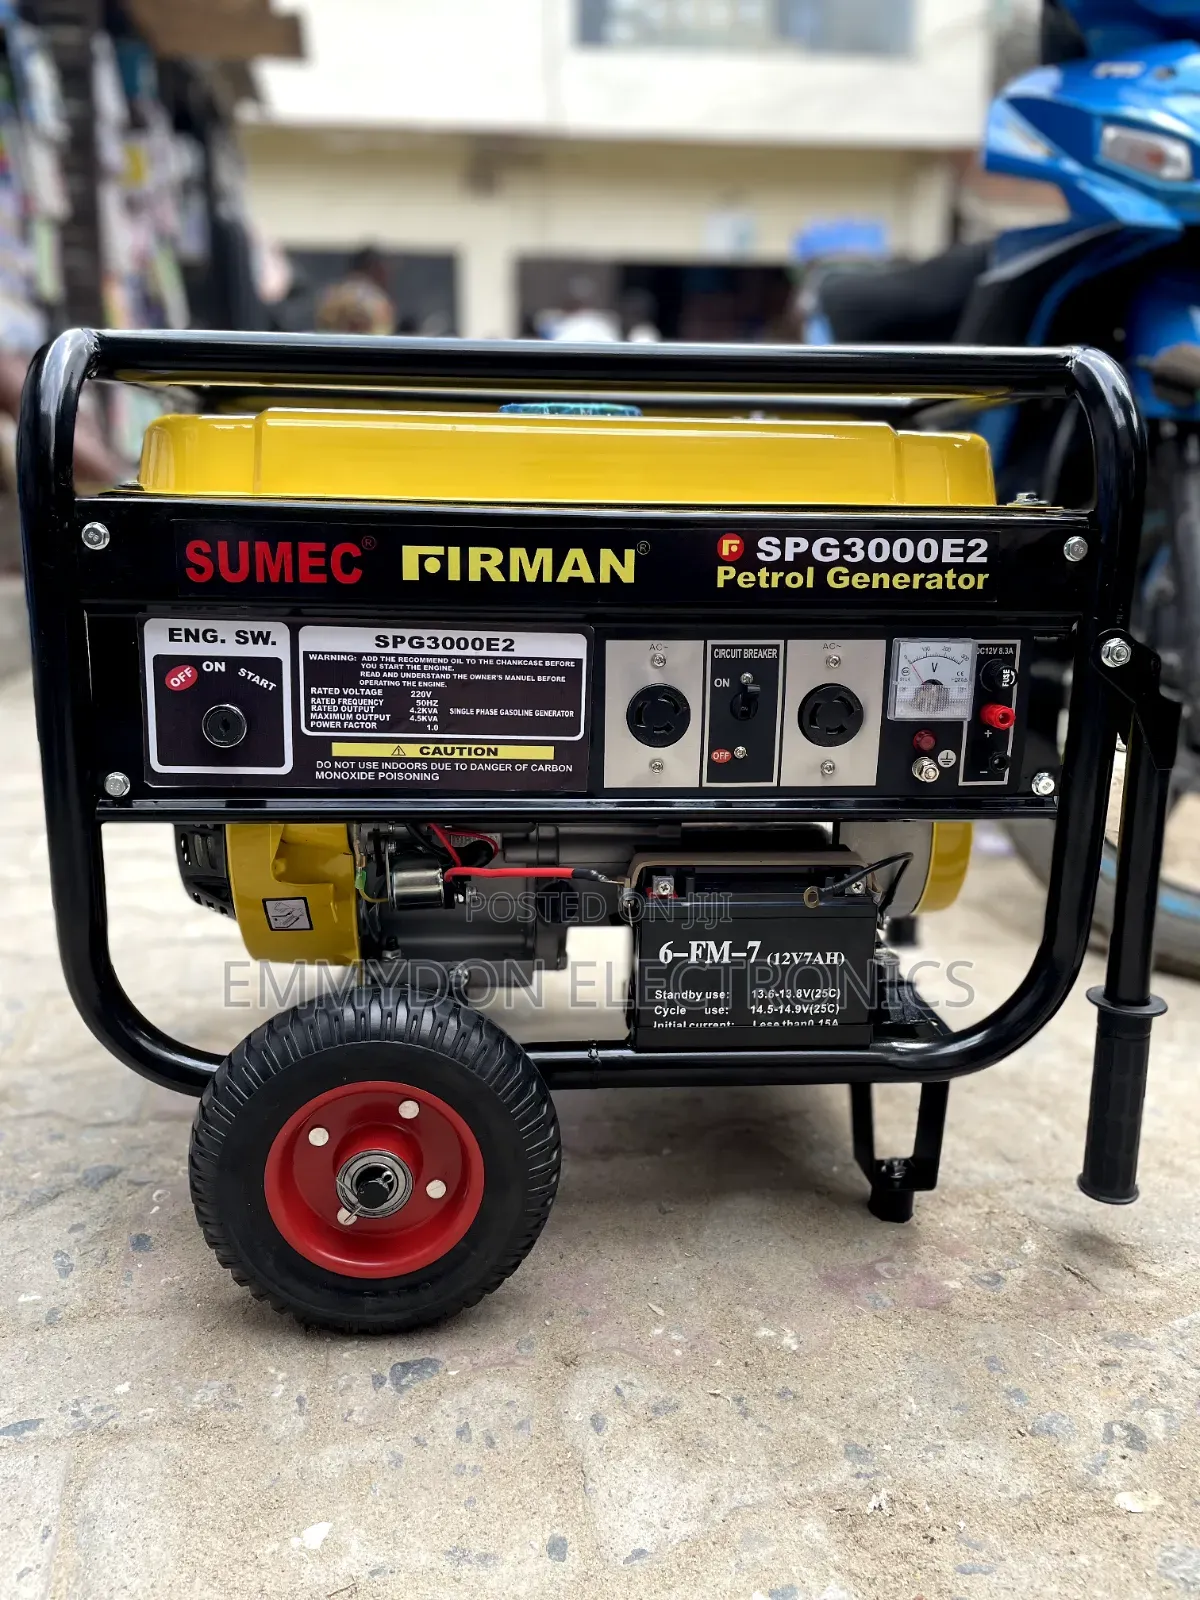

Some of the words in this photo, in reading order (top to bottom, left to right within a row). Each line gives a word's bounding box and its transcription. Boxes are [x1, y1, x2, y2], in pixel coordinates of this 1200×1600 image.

[756, 536, 989, 563] SPG3000E2
[717, 565, 815, 589] Petrol
[826, 566, 989, 590] Generator
[168, 627, 226, 644] ENG.
[235, 629, 277, 646] SW.
[374, 634, 515, 652] SPG3000E2
[713, 648, 742, 659] CIRCUIT
[743, 648, 778, 659] BREAKER
[309, 653, 357, 662] WARNING:
[380, 655, 396, 663] THE
[398, 656, 449, 664] RECOMMEND
[545, 660, 576, 668] BEFORE
[202, 661, 226, 672] ON
[423, 664, 455, 672] ENGINE.
[931, 662, 938, 673] V
[170, 666, 193, 687] OFF
[238, 667, 277, 692] START
[400, 672, 451, 680] UNDERSTAND
[1002, 669, 1011, 687] FUSE
[713, 678, 730, 688] ON
[310, 687, 340, 696] RATED
[342, 687, 384, 696] VOLTAGE
[410, 690, 432, 698] 220V
[310, 697, 336, 705] RATED
[338, 698, 384, 706] FREQUENCY
[415, 699, 439, 707] 50HZ
[340, 705, 375, 713] OUTPUT
[409, 707, 439, 715] 4.2KVA
[449, 707, 475, 715] SINGLE
[475, 708, 499, 716] PHASE
[500, 708, 533, 717] GASOLINE
[534, 709, 575, 718] GENERATOR
[310, 713, 354, 721] MAXIMUM
[355, 713, 391, 722] OUTPUT
[409, 714, 439, 723] 4.5KVA
[310, 721, 342, 729] POWER
[343, 721, 378, 730] FACTOR
[426, 724, 439, 732] 1.0
[419, 746, 499, 757] CAUTION
[713, 751, 730, 760] OFF
[316, 760, 332, 769] DO
[334, 761, 356, 770] NOT
[358, 761, 380, 770] USE
[381, 762, 428, 771] INDOORS
[430, 762, 452, 771] DUE
[454, 762, 468, 771] TO
[470, 763, 513, 772] DANGER
[514, 763, 529, 772] OF
[530, 764, 573, 773] CARBON
[315, 771, 376, 780] MONOXIDE
[378, 772, 440, 781] POISONING
[766, 951, 845, 967] (12V7AH)
[655, 989, 702, 1001] Standby
[705, 989, 730, 1000] use:
[654, 1005, 687, 1018] Cycle
[704, 1006, 729, 1015] use:
[653, 1020, 687, 1028] Initial
